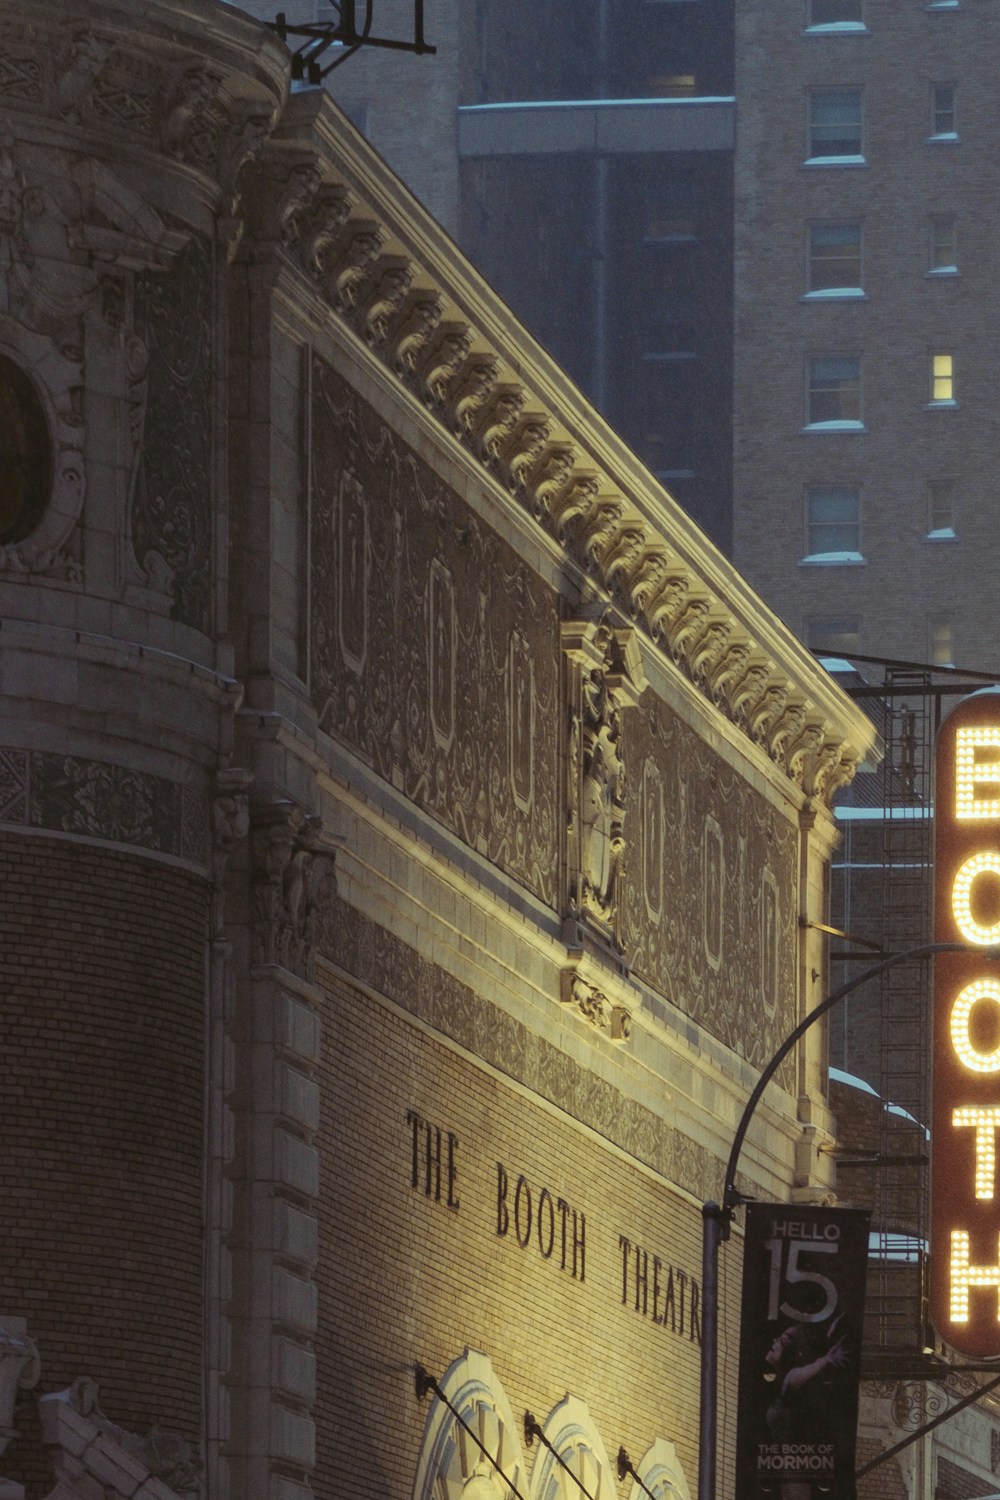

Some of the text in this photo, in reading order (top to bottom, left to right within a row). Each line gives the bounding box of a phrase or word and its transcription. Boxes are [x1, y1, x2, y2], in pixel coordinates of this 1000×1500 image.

[406, 1110, 460, 1212] THE
[496, 1161, 587, 1283] BOOTH
[772, 1220, 841, 1240] HELLO
[765, 1239, 839, 1323] 15
[758, 1444, 834, 1455] THE BOOK OF
[757, 1455, 835, 1470] MORMON
